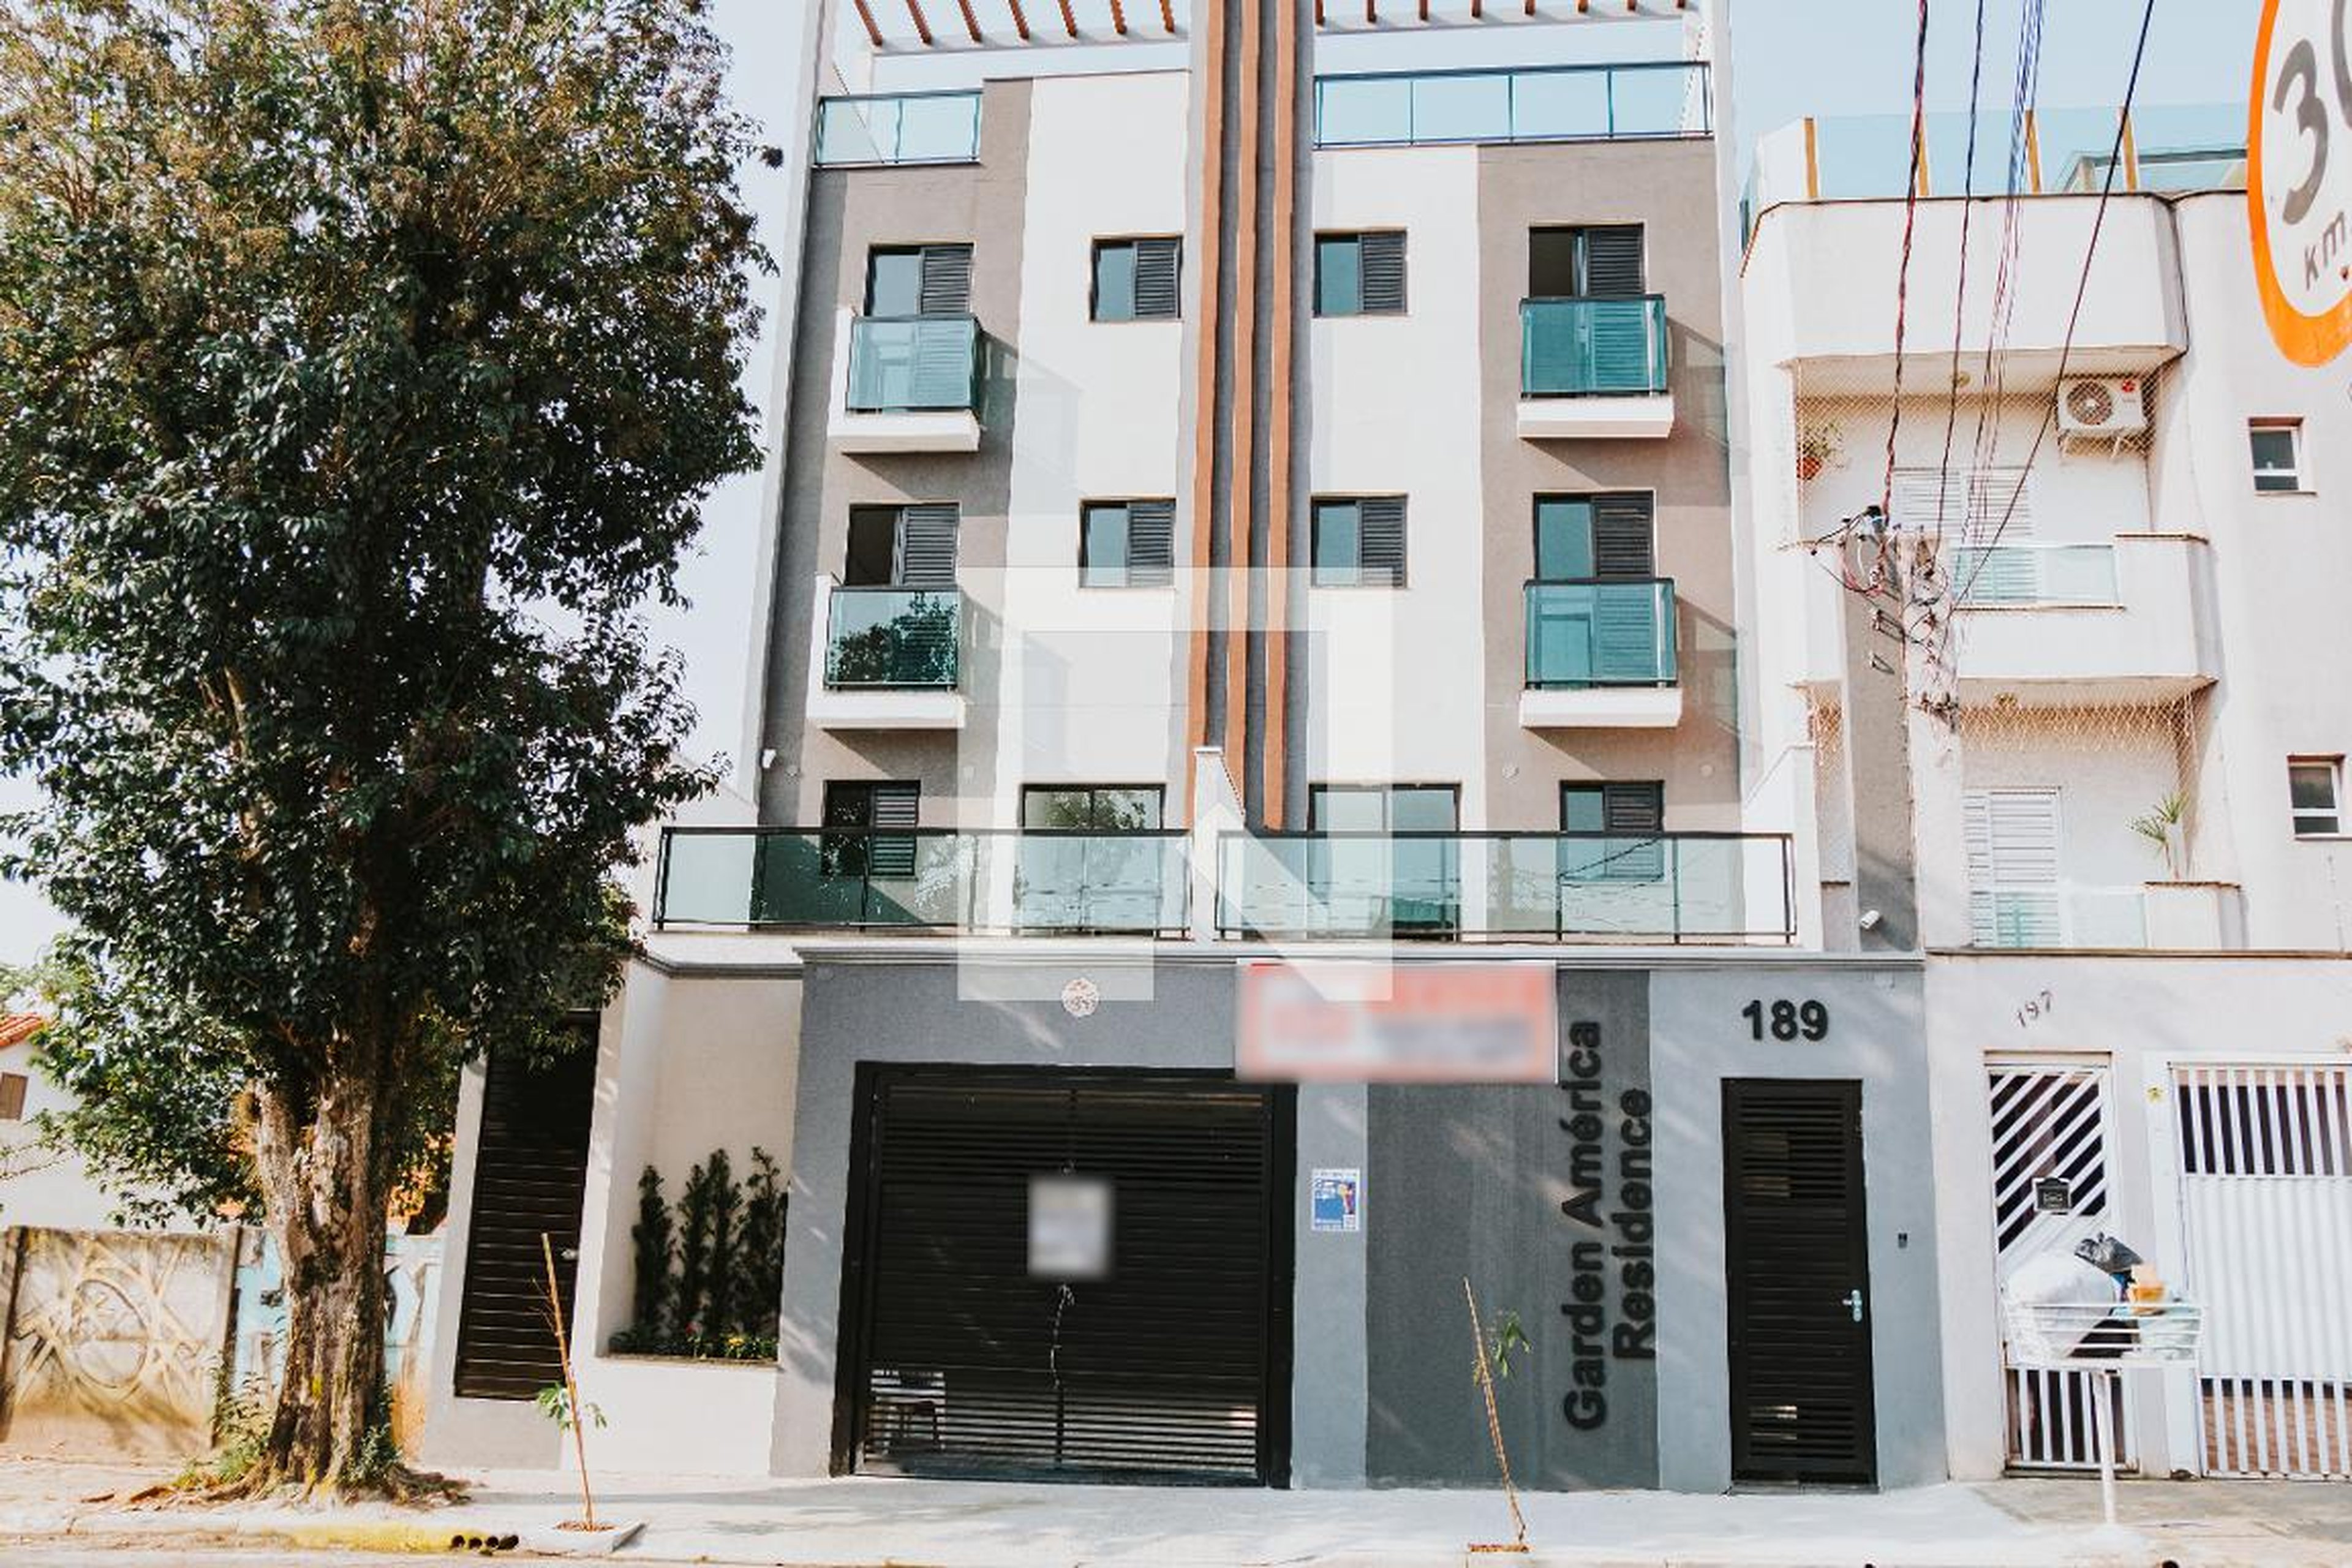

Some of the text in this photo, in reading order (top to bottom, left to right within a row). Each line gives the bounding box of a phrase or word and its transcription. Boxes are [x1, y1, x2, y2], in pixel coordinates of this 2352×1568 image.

[1743, 1000, 1829, 1041] 189
[1559, 1020, 1607, 1431] Garden América
[1611, 1088, 1656, 1359] Residence
